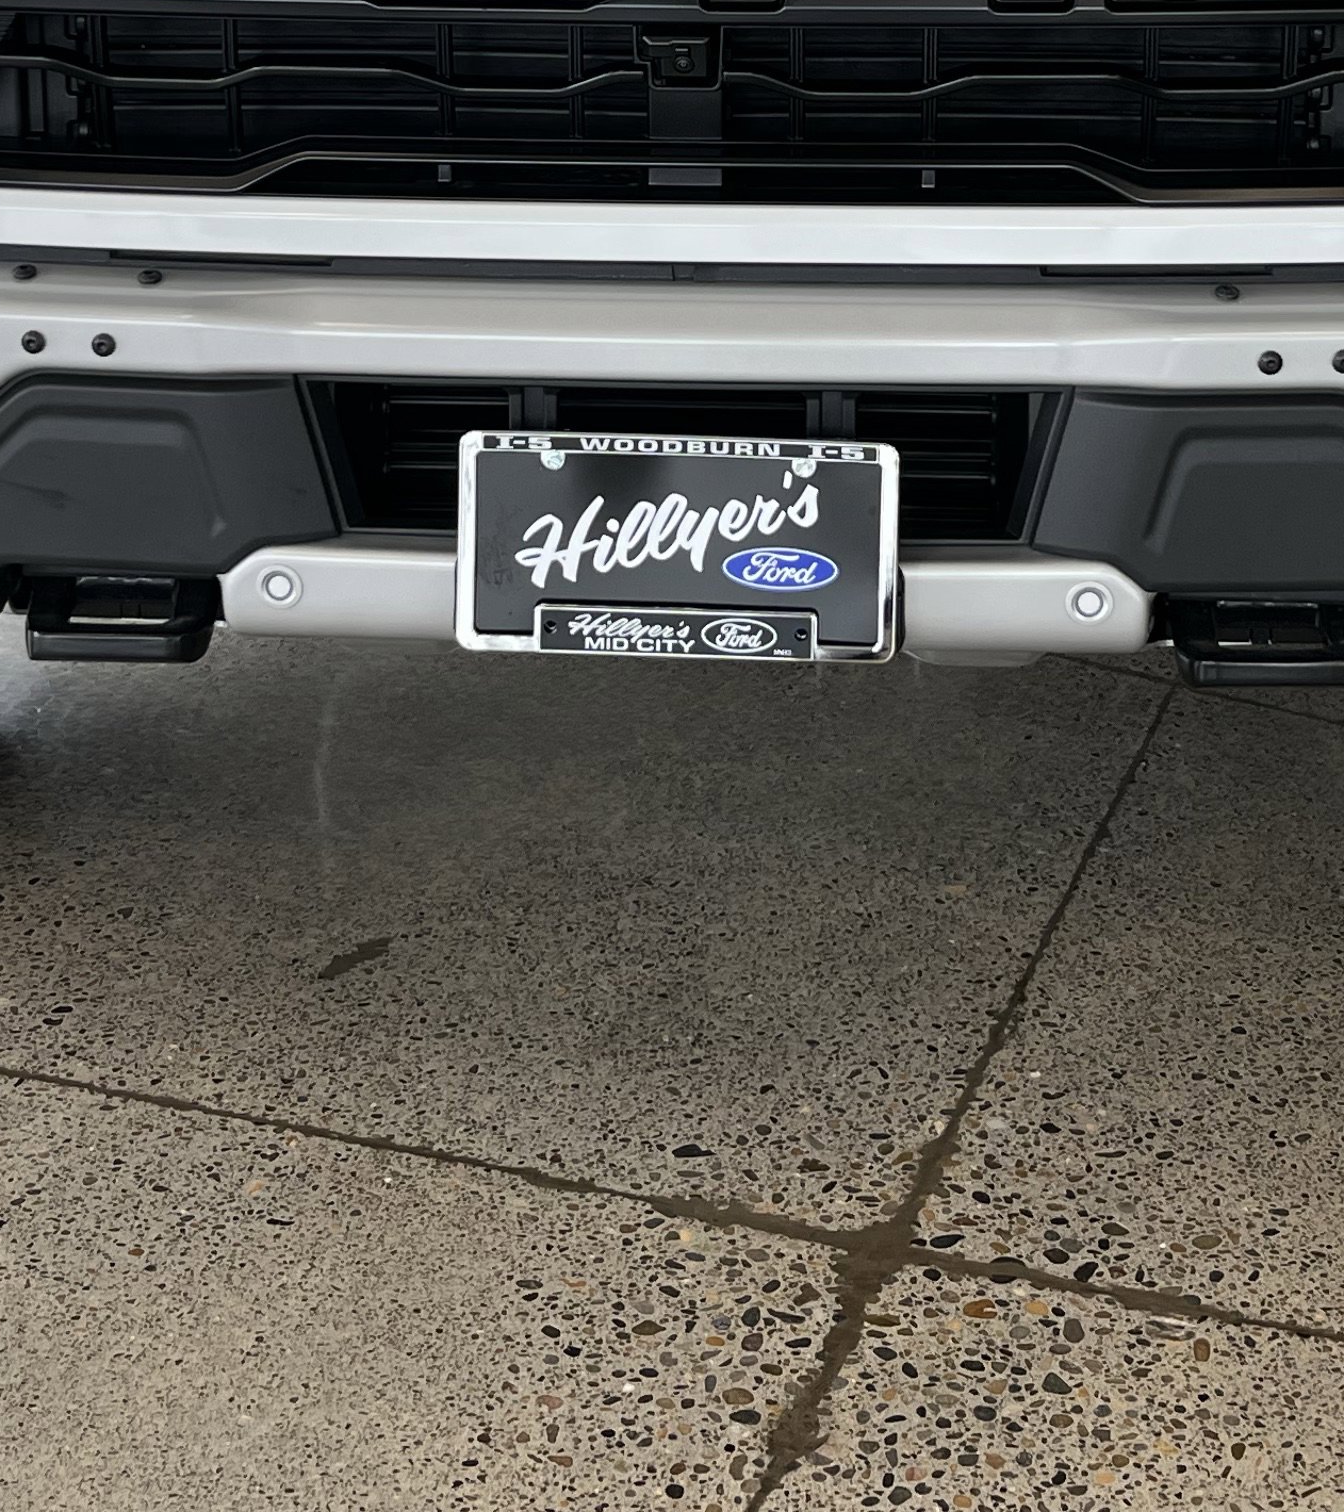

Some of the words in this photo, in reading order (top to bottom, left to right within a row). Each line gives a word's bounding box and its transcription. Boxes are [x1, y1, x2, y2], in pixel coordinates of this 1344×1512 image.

[495, 435, 553, 449] I-5
[579, 437, 781, 457] WOODBURN
[807, 444, 865, 461] I-5
[515, 471, 819, 588] Hillyer's
[742, 551, 816, 585] Ford
[567, 612, 691, 644] Hillyer's
[714, 622, 764, 650] Ford
[584, 636, 630, 651] MID
[636, 638, 696, 653] CITY
